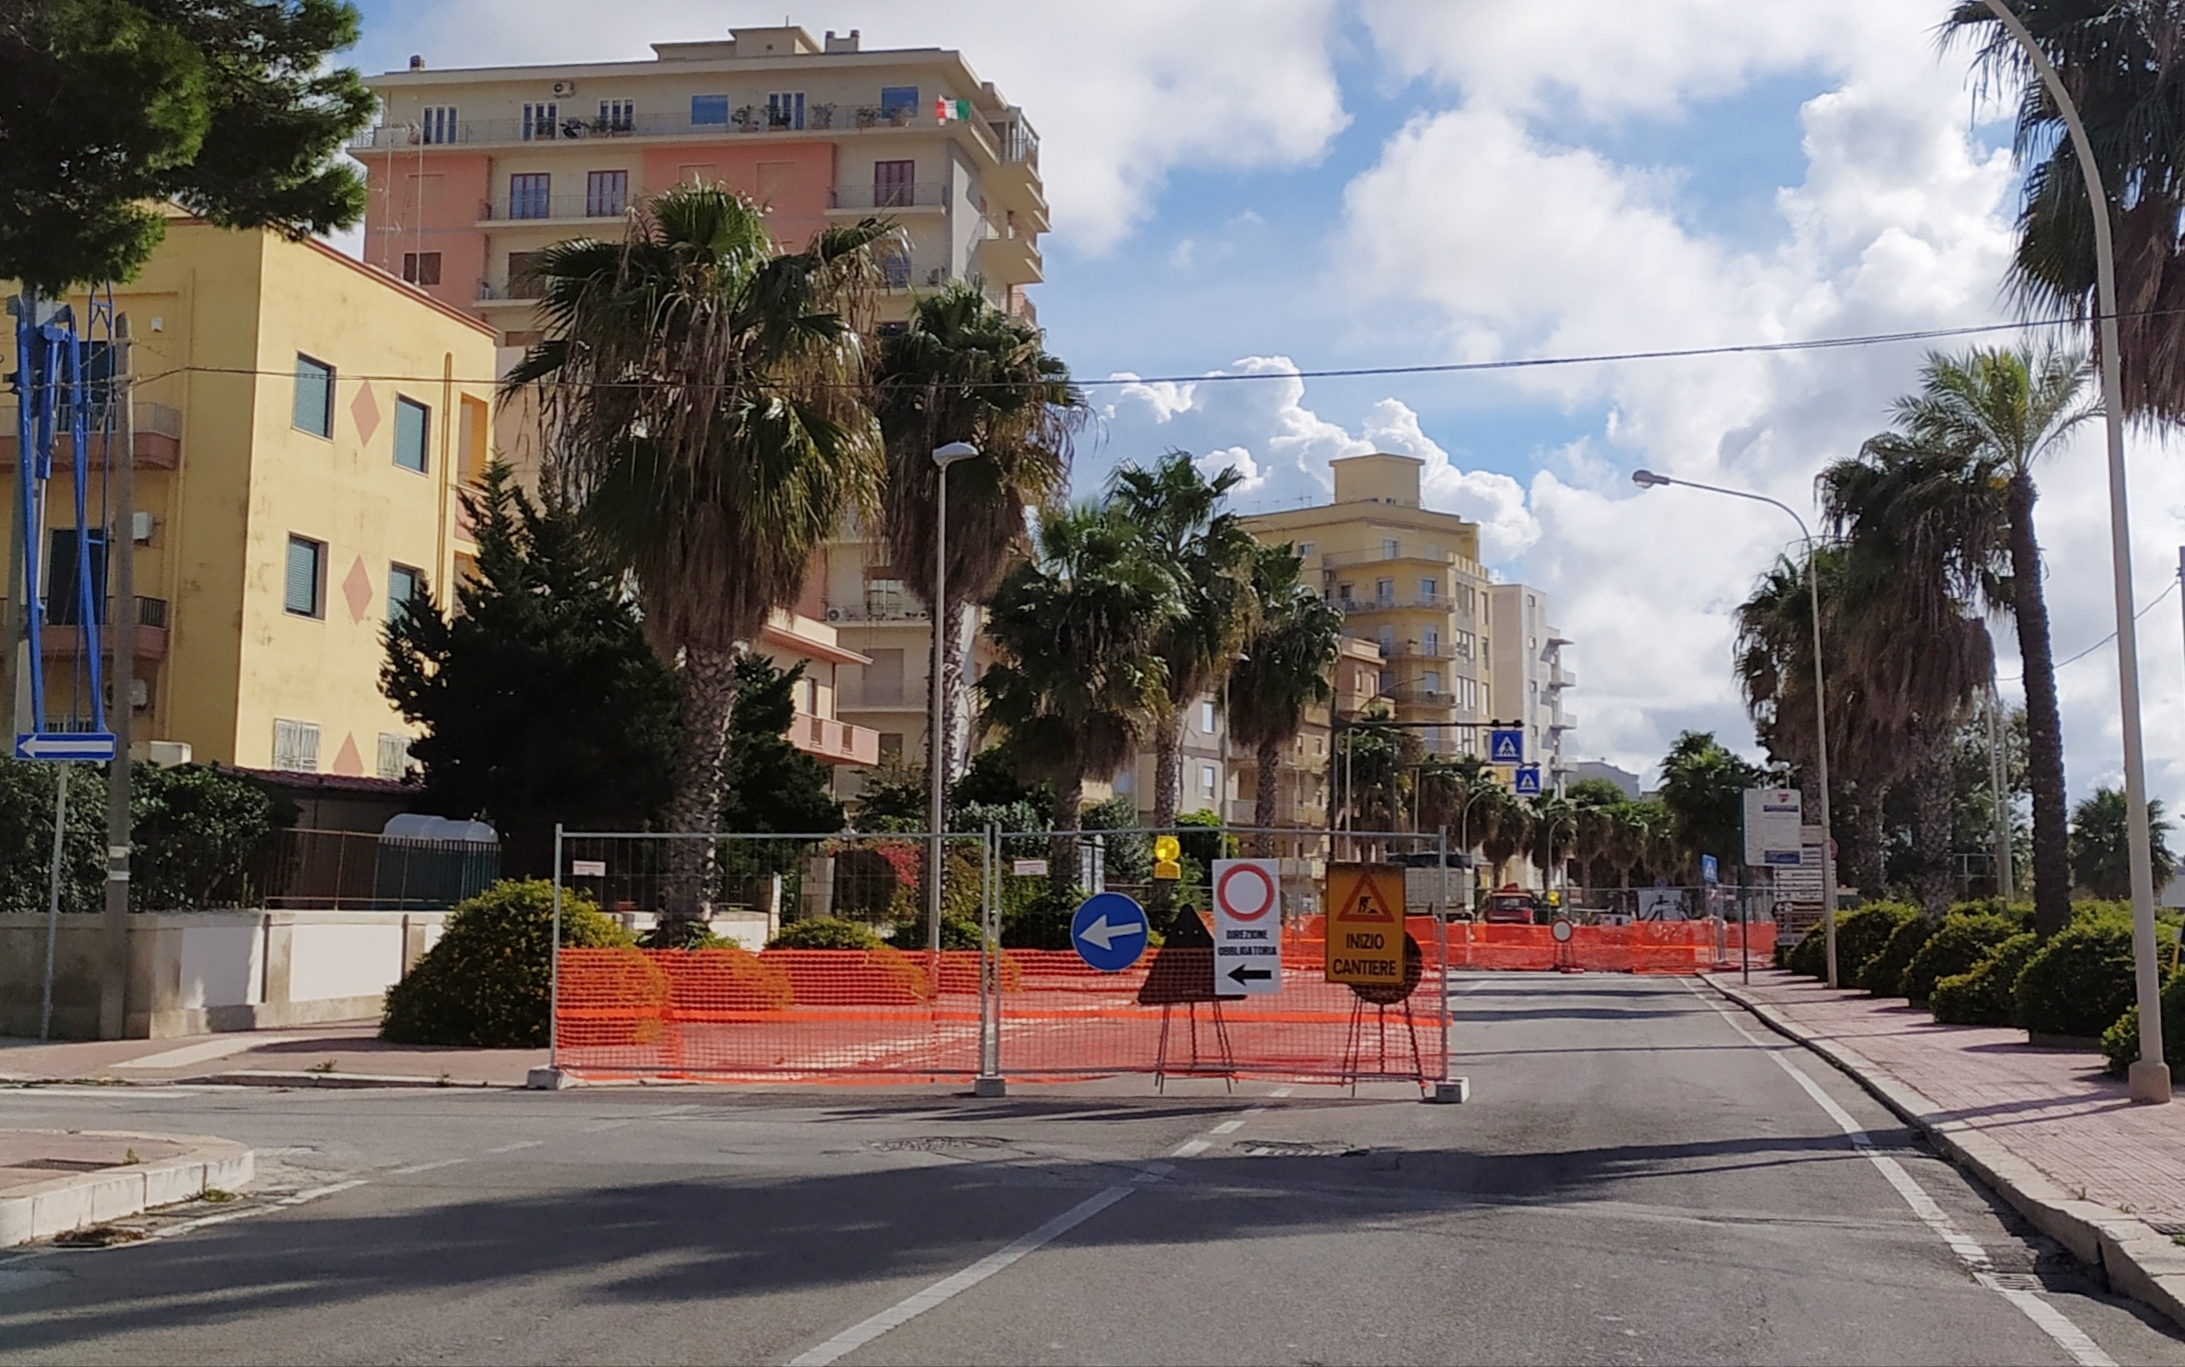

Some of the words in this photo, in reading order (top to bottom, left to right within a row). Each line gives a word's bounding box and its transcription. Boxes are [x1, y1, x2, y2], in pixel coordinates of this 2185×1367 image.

[1226, 930, 1268, 940] DIREZIONE
[1346, 933, 1385, 950] INIZIO
[1218, 946, 1277, 956] OBBLIGATORIA
[1333, 959, 1397, 976] CANTIERE
